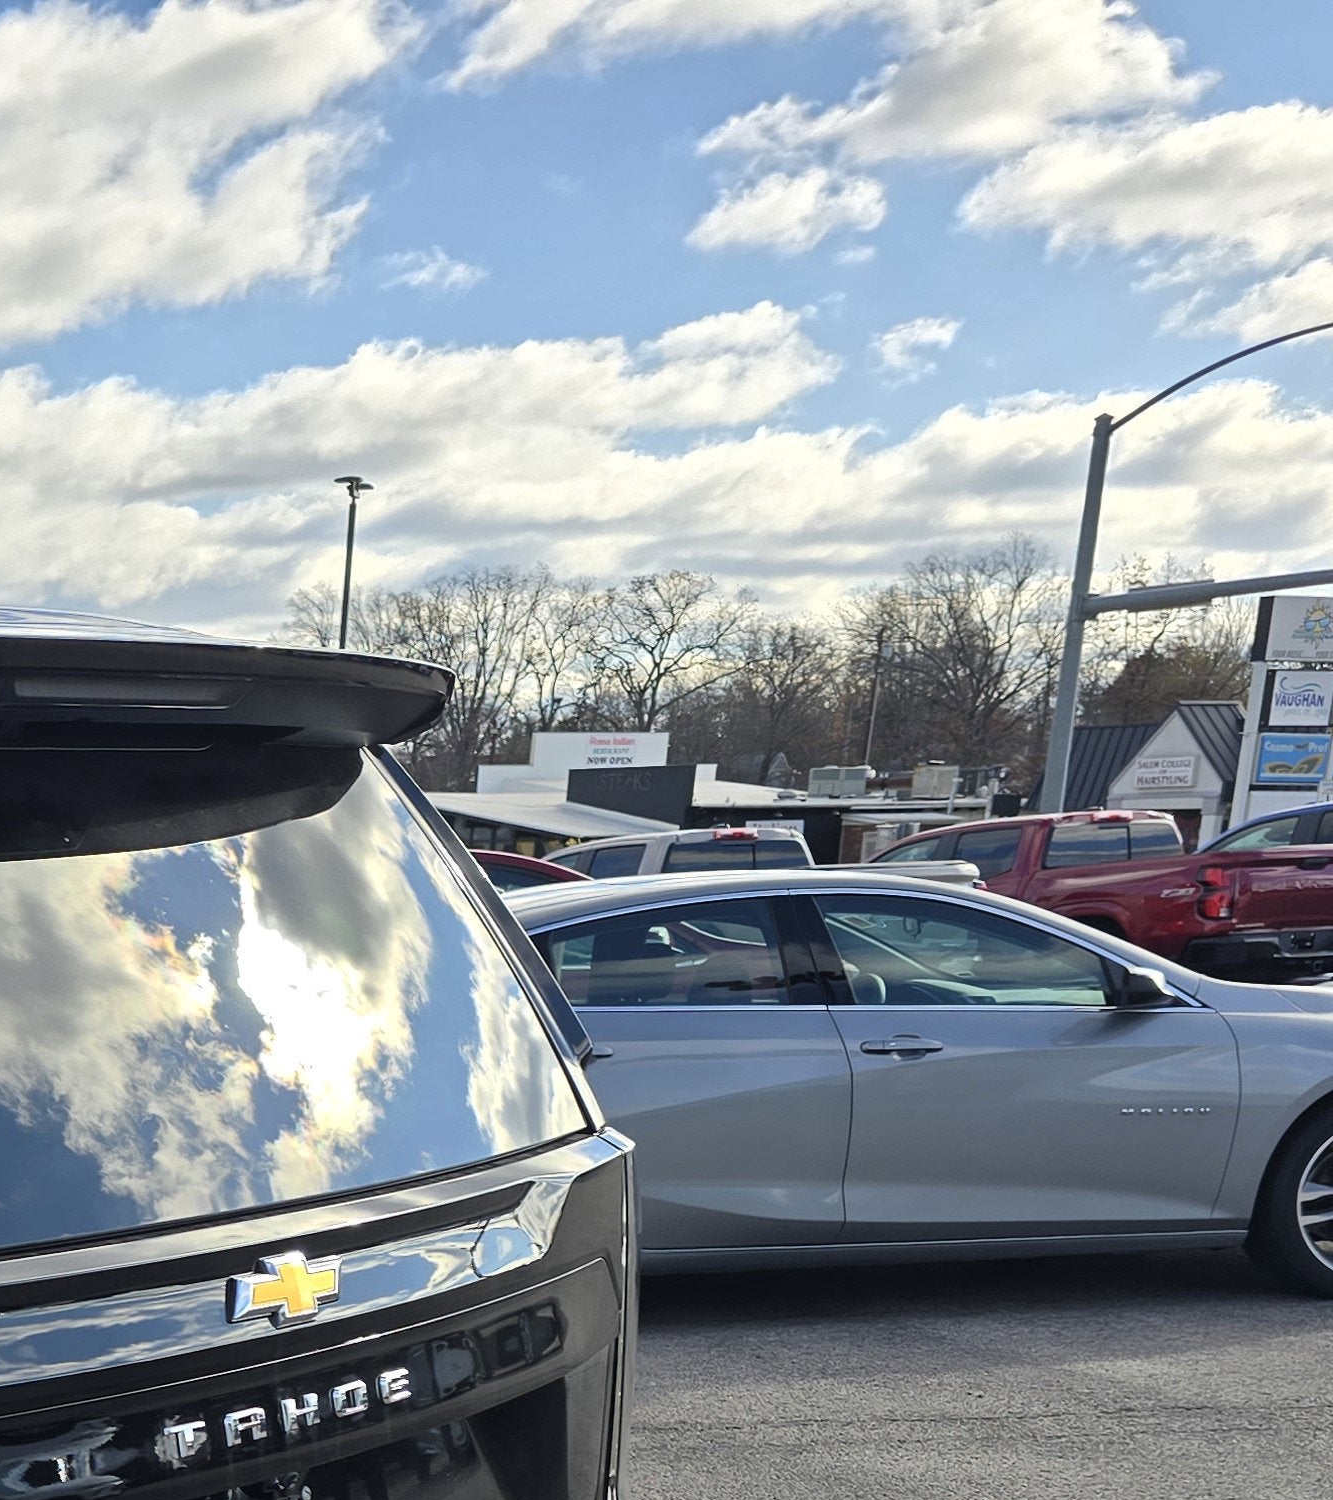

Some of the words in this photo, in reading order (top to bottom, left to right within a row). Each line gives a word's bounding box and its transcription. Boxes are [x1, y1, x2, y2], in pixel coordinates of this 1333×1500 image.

[1275, 693, 1325, 707] VAUGHAN
[1137, 760, 1160, 769] SALEM
[1161, 759, 1192, 768] COLLEGE
[1137, 775, 1189, 785] HAIRSTYLING
[164, 1367, 412, 1458] TAHOE
